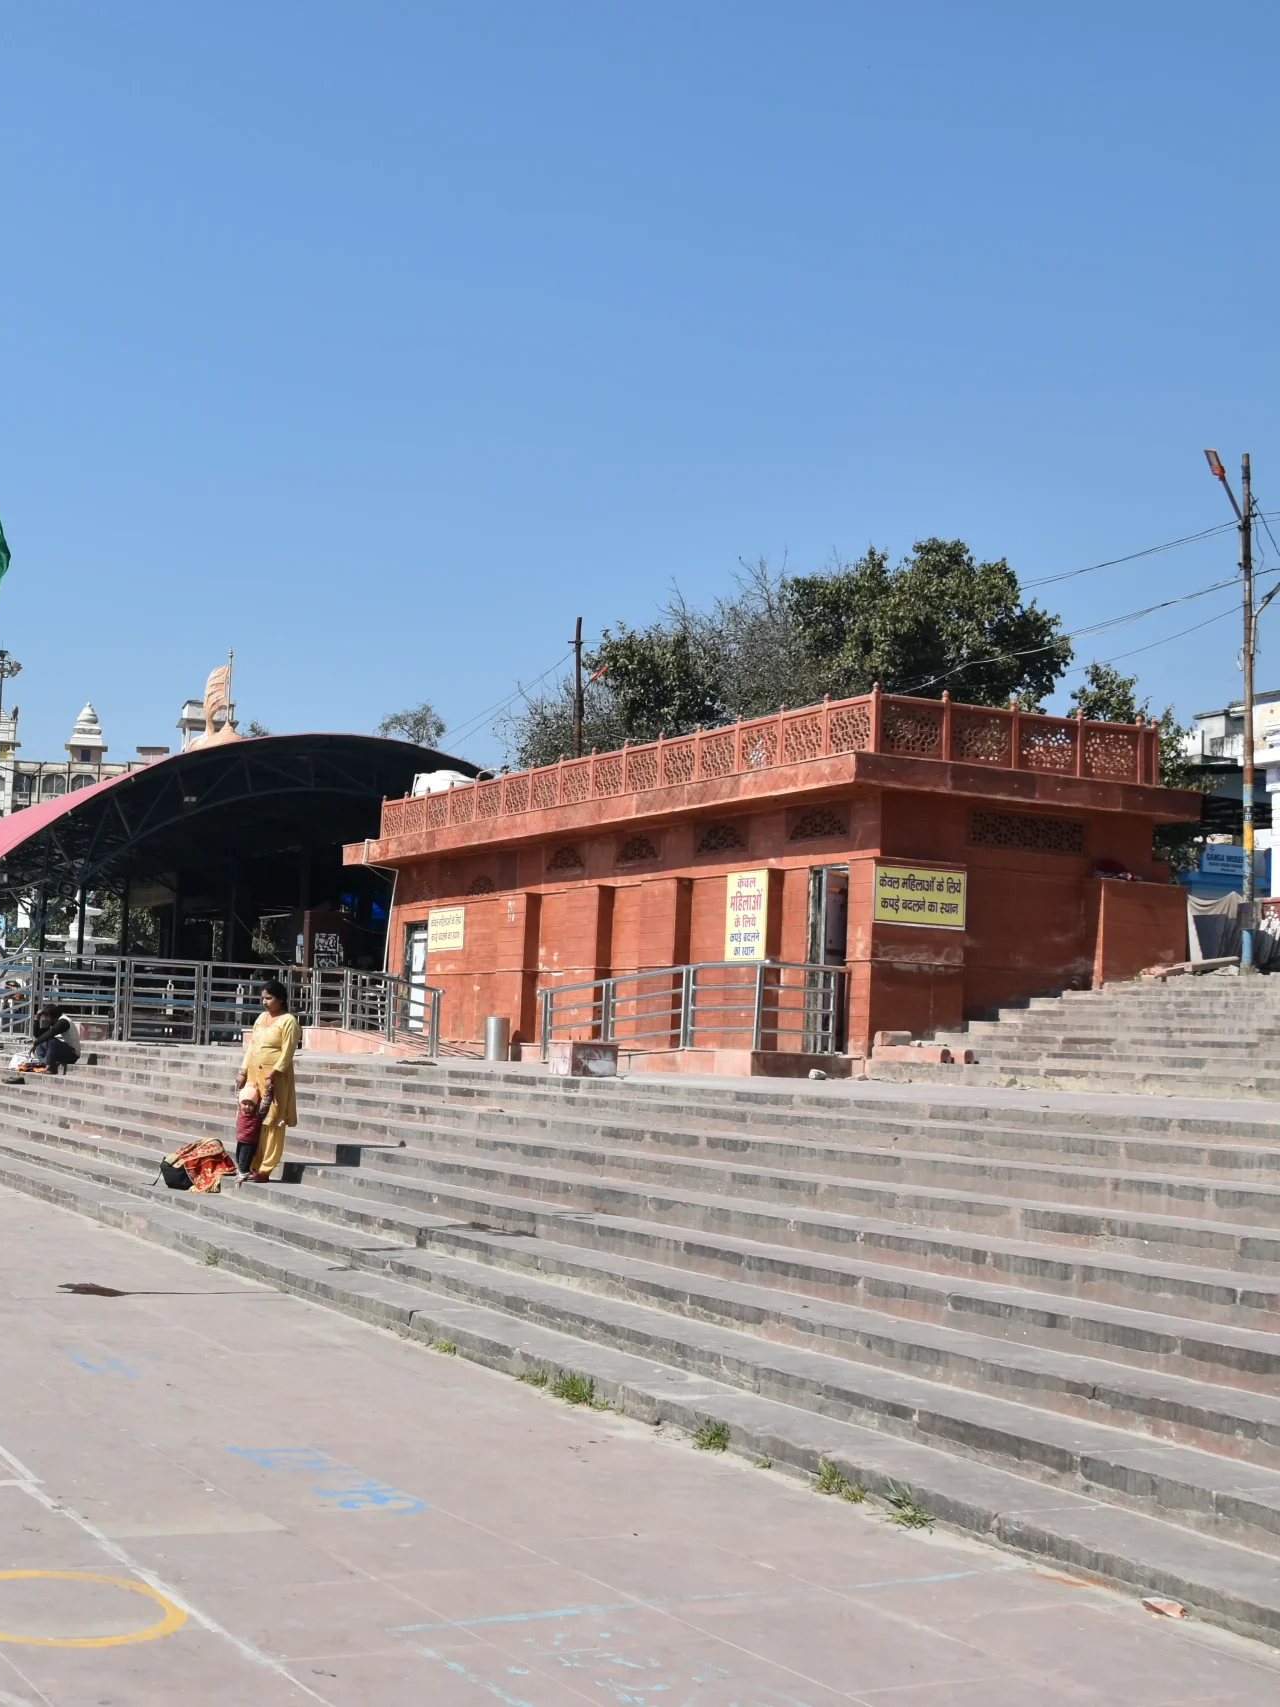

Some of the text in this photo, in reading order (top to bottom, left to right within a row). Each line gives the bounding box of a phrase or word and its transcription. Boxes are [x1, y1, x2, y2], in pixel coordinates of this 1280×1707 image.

[1206, 853, 1244, 863] GANGA MUSE
[737, 875, 756, 888] केवल
[879, 872, 961, 894] केवल महिलाओं के लिये
[730, 889, 763, 911] महिलाओं
[881, 895, 959, 914] कपड़े बदलने का स्थान
[734, 914, 756, 928] के लिये
[730, 929, 760, 945] कपड़े बदलने
[733, 946, 755, 956] का स्थान
